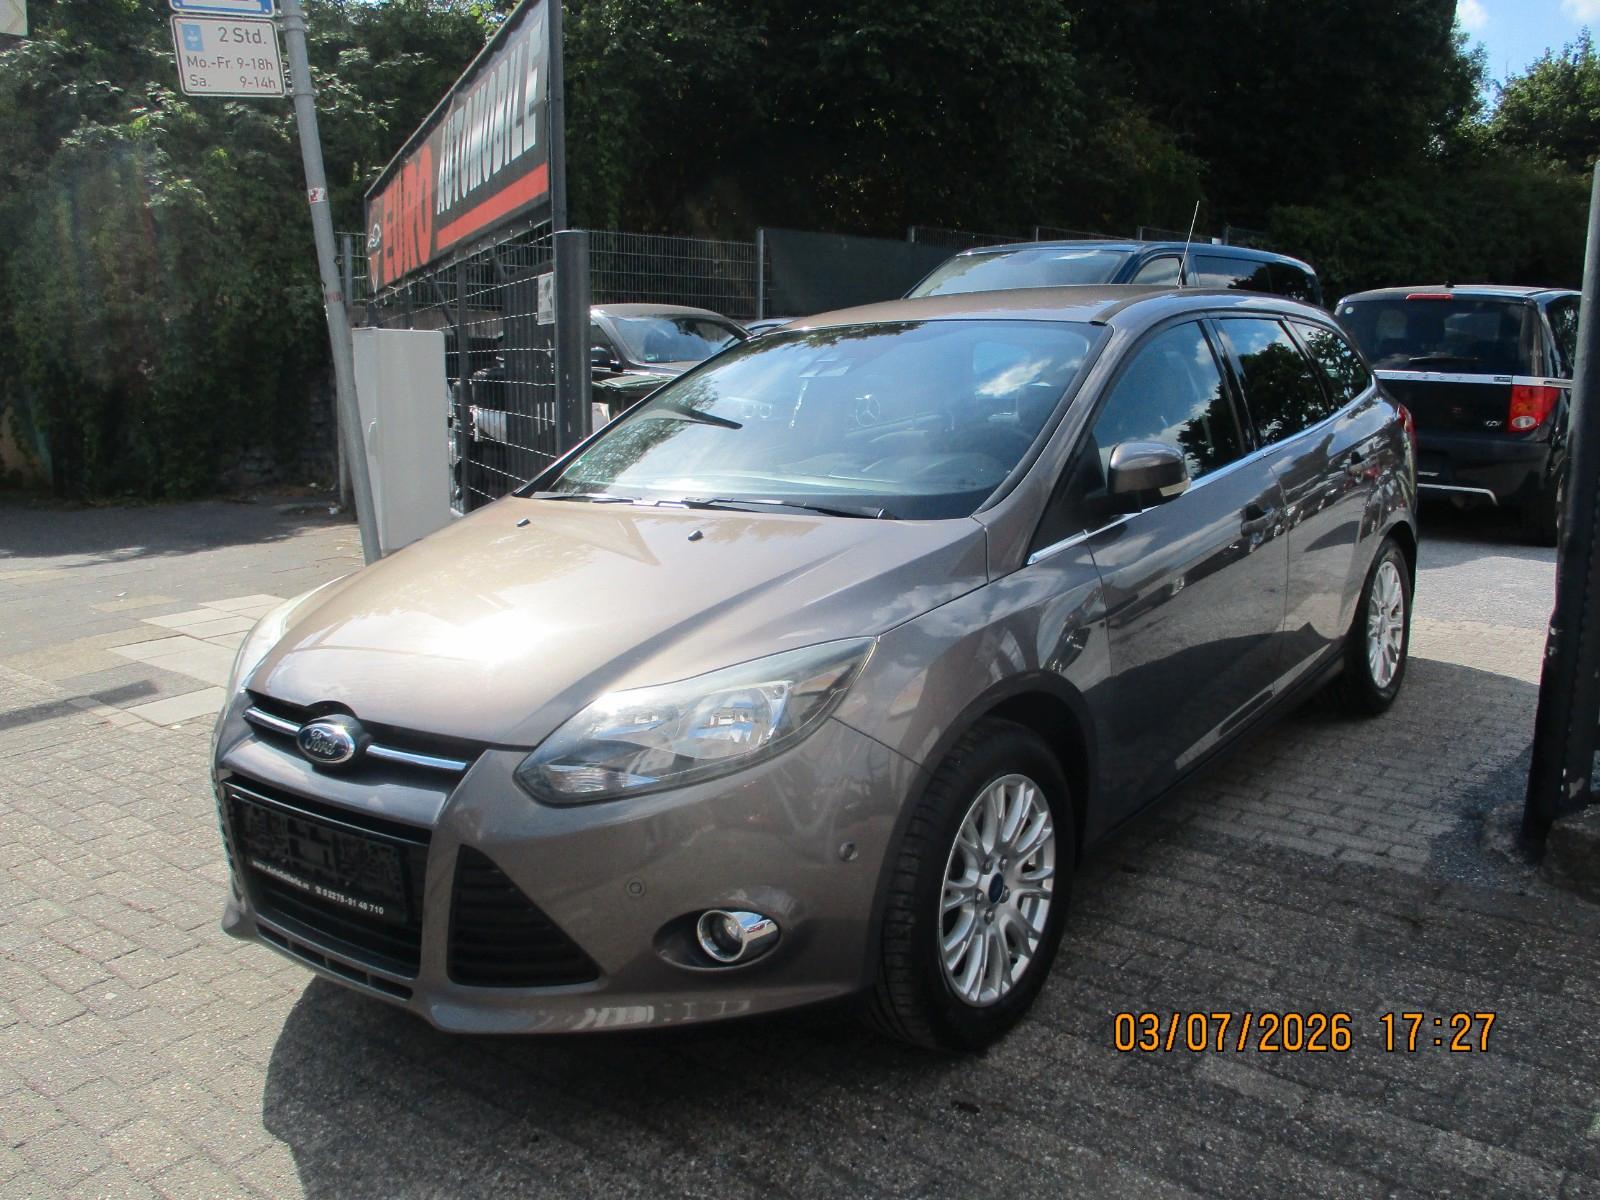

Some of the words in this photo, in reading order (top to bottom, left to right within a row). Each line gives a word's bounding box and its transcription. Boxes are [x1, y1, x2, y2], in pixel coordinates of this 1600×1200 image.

[217, 26, 229, 43] 2
[232, 27, 267, 45] Std.
[186, 55, 234, 70] Mo.-Fr.
[236, 57, 273, 71] 9-18h
[189, 74, 212, 88] Sa.
[239, 75, 276, 89] 9-14h
[383, 144, 432, 285] EURO
[437, 20, 542, 215] AUTOMOBILE
[304, 728, 338, 756] Ford
[369, 904, 384, 915] 710
